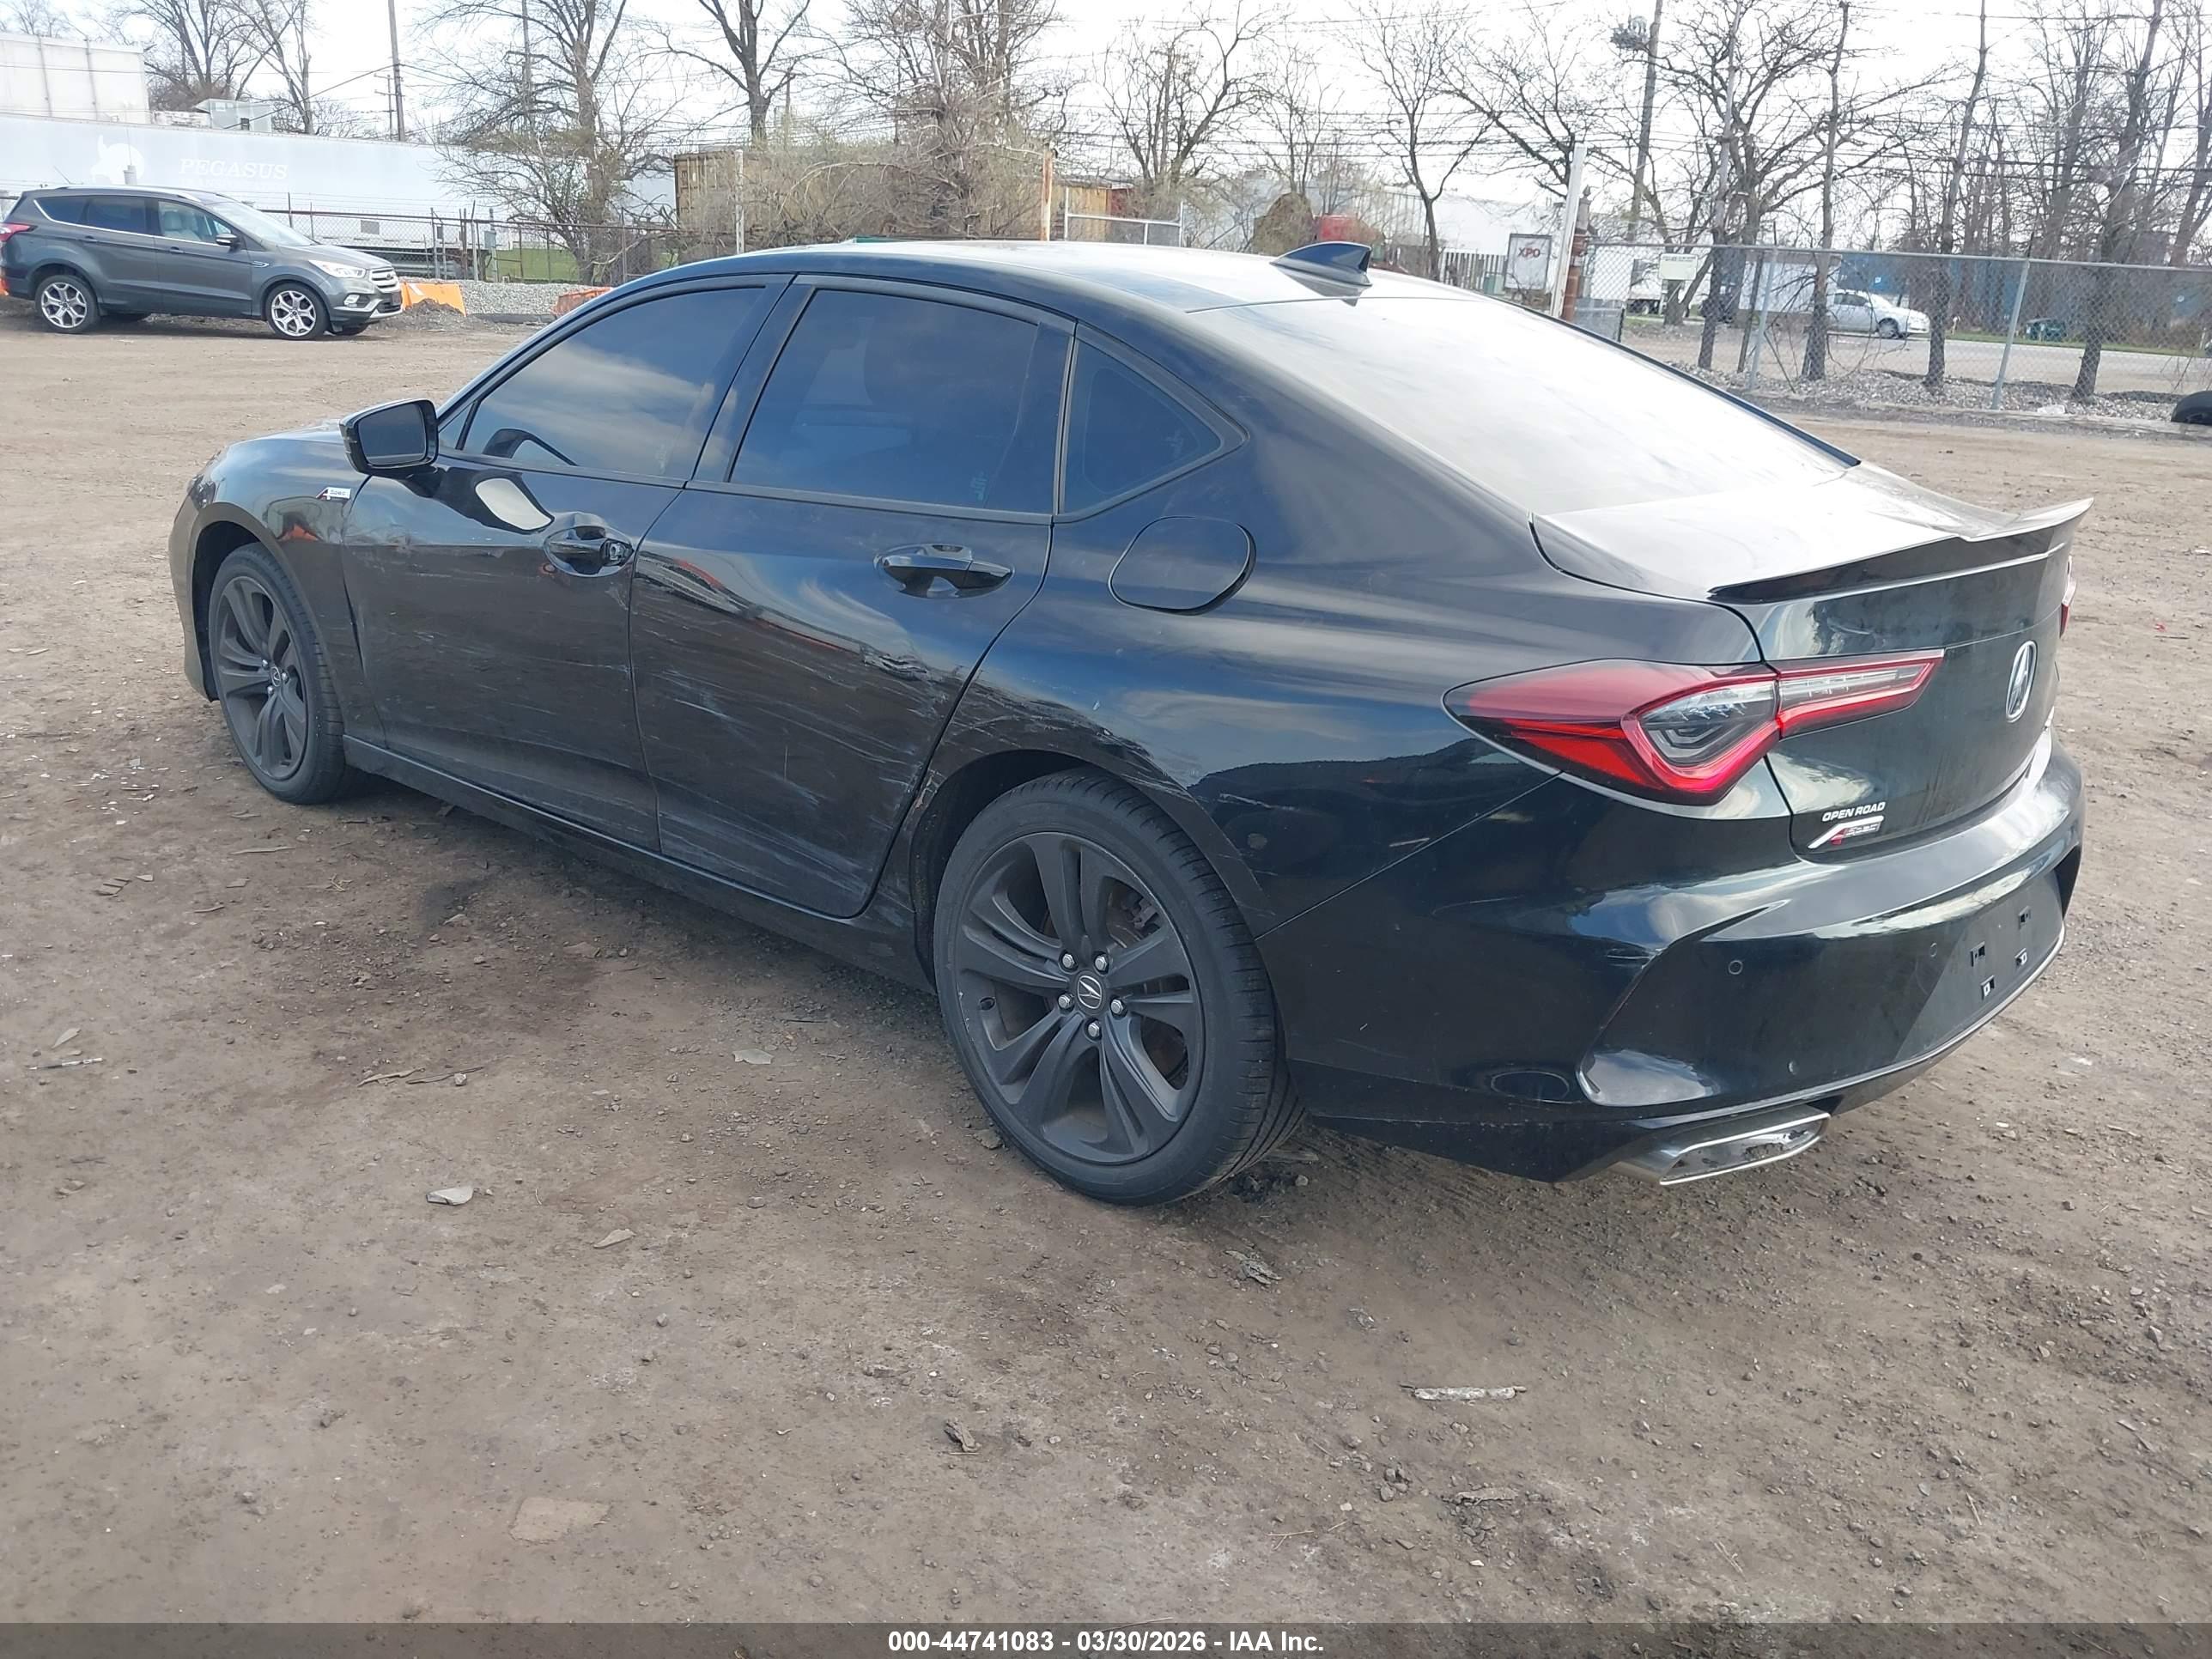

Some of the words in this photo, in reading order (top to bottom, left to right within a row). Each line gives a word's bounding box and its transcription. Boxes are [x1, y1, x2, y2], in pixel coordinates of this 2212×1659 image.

[178, 158, 289, 179] PEGASUS
[1517, 247, 1540, 258] XPO
[1821, 808, 1855, 822] OPEN
[1855, 801, 1886, 816] ROAD
